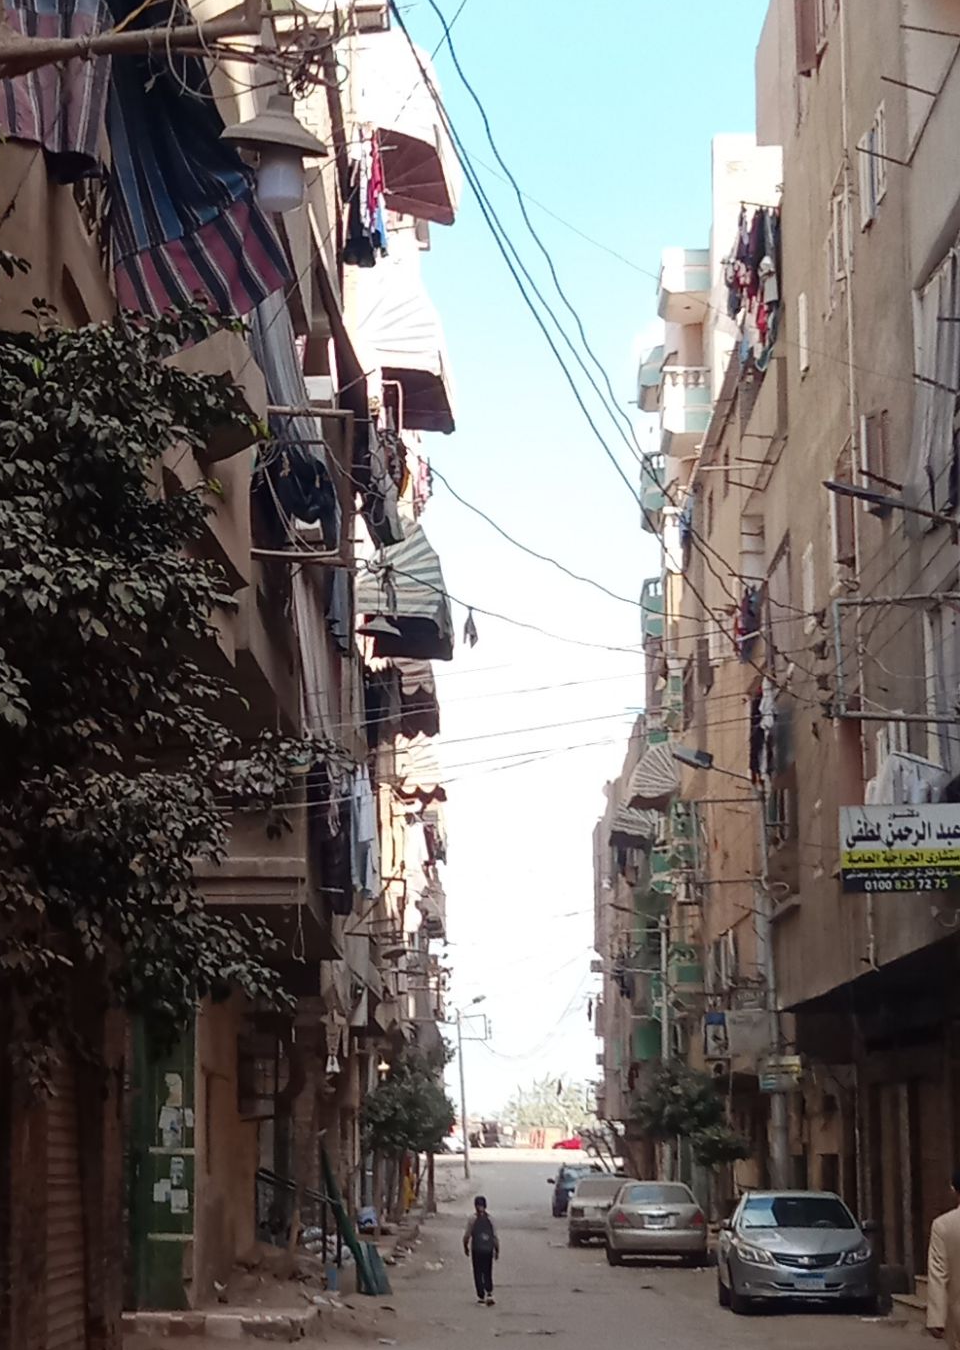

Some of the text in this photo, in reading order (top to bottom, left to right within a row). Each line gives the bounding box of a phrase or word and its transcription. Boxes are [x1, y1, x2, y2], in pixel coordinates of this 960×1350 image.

[886, 820, 932, 848] الرحمن
[936, 822, 960, 846] عبد
[864, 880, 892, 891] 0100
[918, 879, 932, 890] 72
